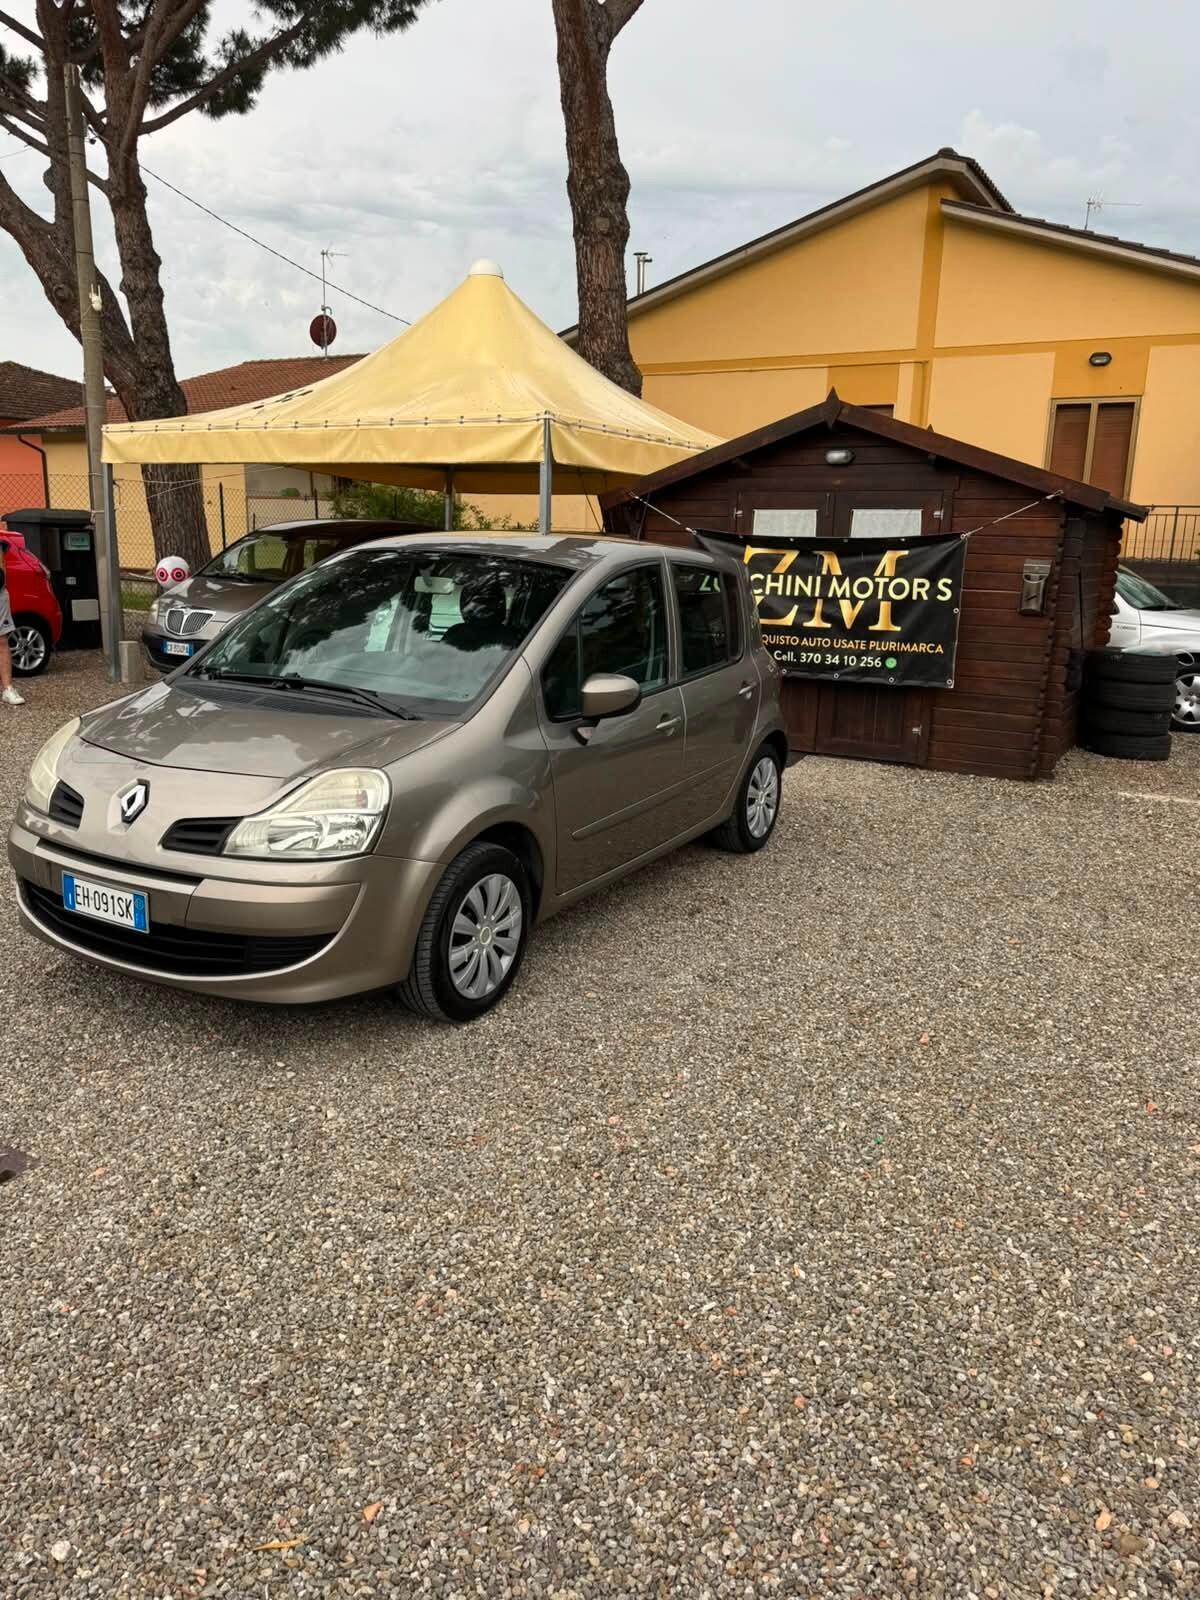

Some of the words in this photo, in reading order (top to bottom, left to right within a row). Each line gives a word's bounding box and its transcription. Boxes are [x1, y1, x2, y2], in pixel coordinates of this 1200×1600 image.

[761, 634, 799, 646] QUISTO
[801, 636, 831, 648] AUTO
[833, 638, 867, 651] USATE
[869, 640, 944, 654] PLURIMARCA
[773, 650, 797, 662] Cell.
[800, 652, 822, 664] 370
[824, 654, 840, 665] 34
[843, 655, 857, 666] 10
[859, 656, 882, 668] 256
